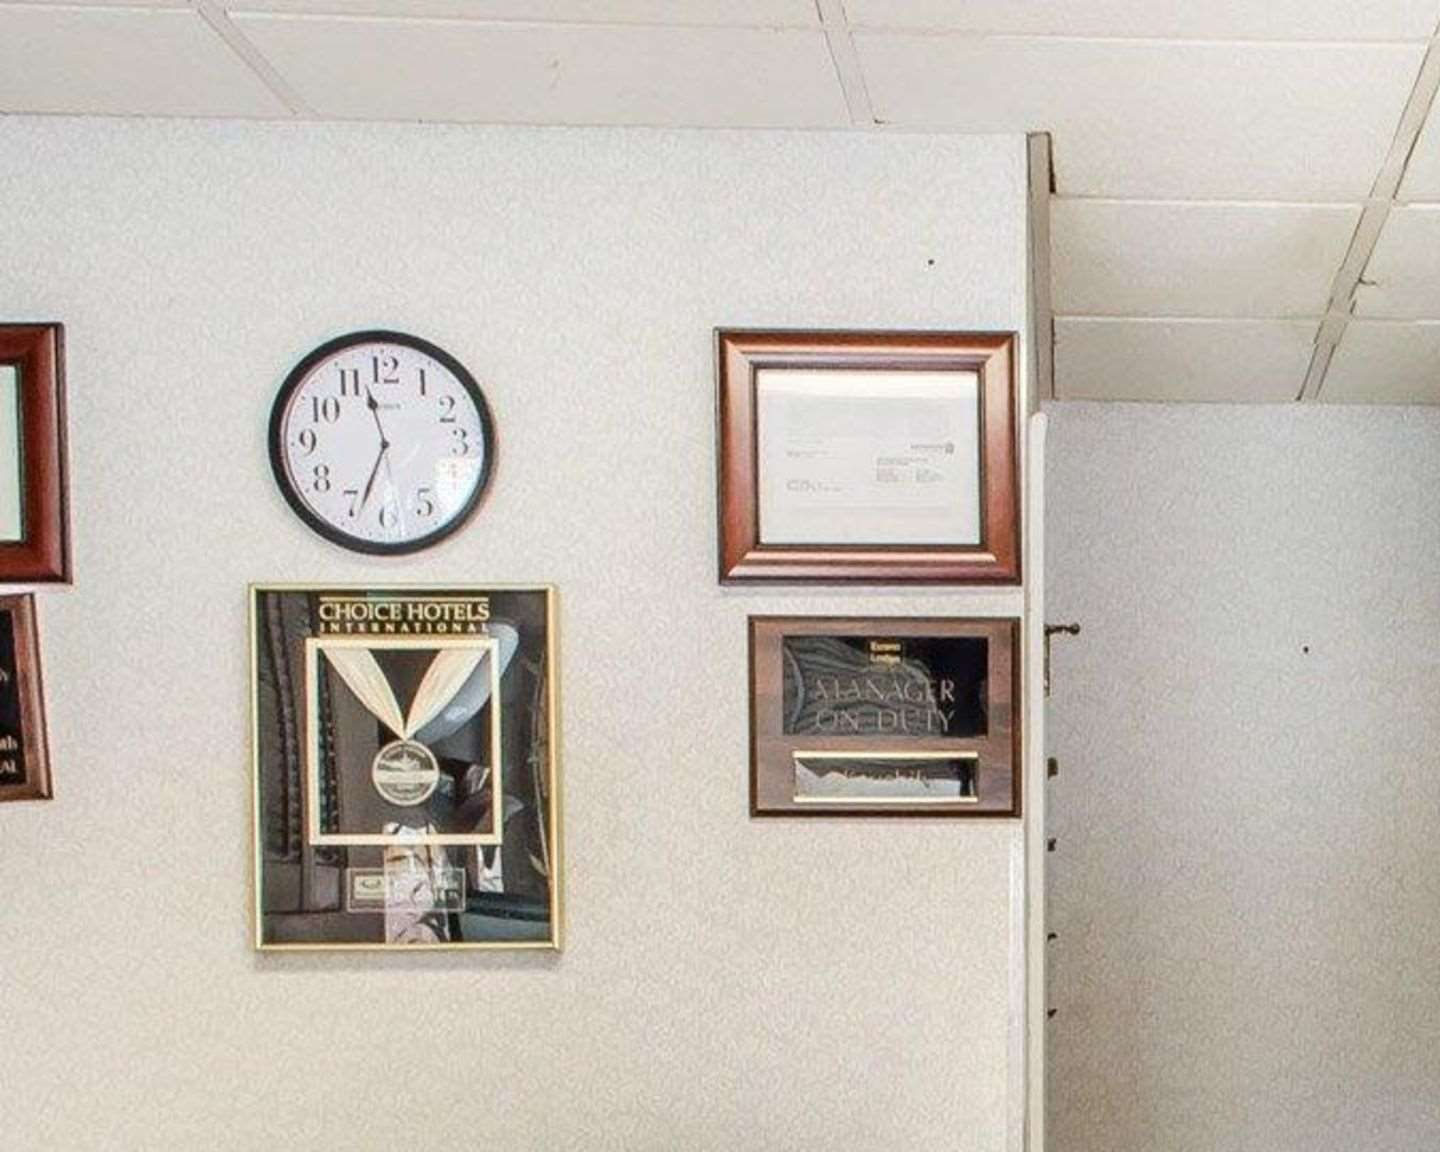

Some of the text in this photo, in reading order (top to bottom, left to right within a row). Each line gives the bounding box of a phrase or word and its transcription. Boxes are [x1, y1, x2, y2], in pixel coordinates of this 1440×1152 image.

[339, 369, 361, 397] 11
[372, 356, 399, 384] 12
[418, 369, 427, 396] 1
[312, 395, 340, 424] 10
[439, 395, 456, 424] 2
[299, 428, 318, 457] 9
[451, 428, 469, 457] 3
[312, 464, 331, 493] 8
[342, 489, 359, 518] 7
[378, 501, 399, 529] 6
[416, 488, 434, 518] 5
[319, 602, 490, 621] CHOICE HOTELS
[319, 622, 490, 633] INTERNATIONAL
[815, 678, 956, 703] MANAGER
[815, 708, 955, 732] ON DUTY
